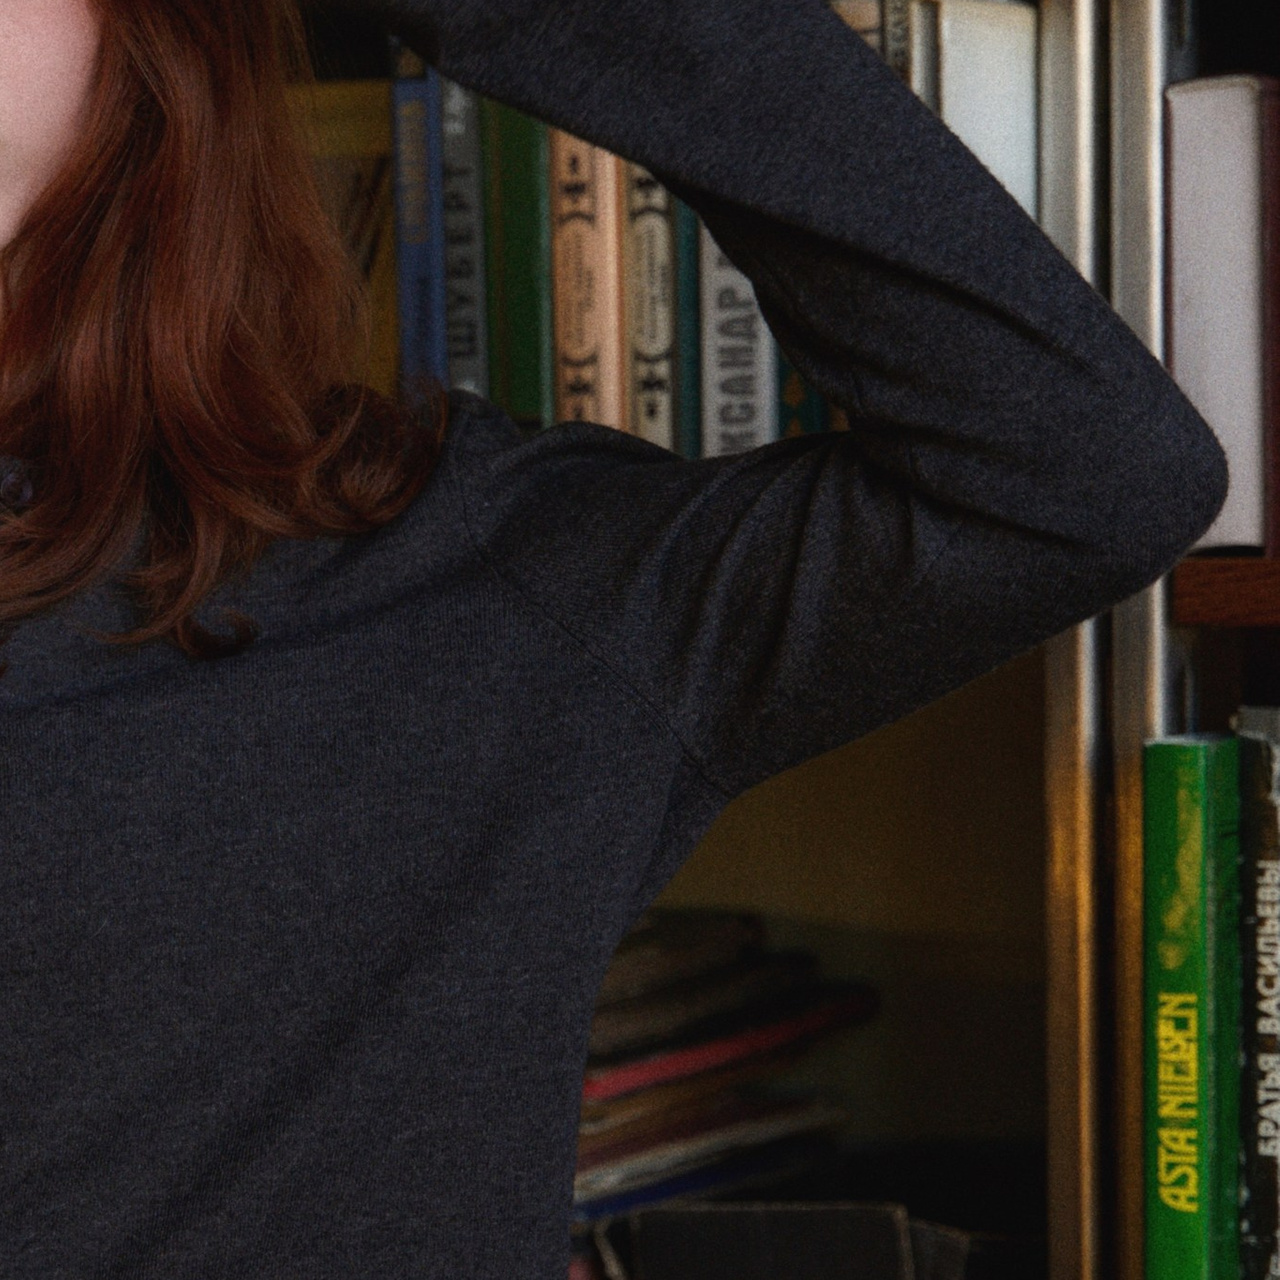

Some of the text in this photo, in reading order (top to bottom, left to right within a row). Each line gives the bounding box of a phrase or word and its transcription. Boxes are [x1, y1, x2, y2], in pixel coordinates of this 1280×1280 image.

[443, 163, 476, 359] ШУБЕРТ
[1157, 992, 1199, 1213] ASTA NIELSEN
[1255, 859, 1280, 1157] БРАТЬЯ ВАСИЛЬЕВЫ
